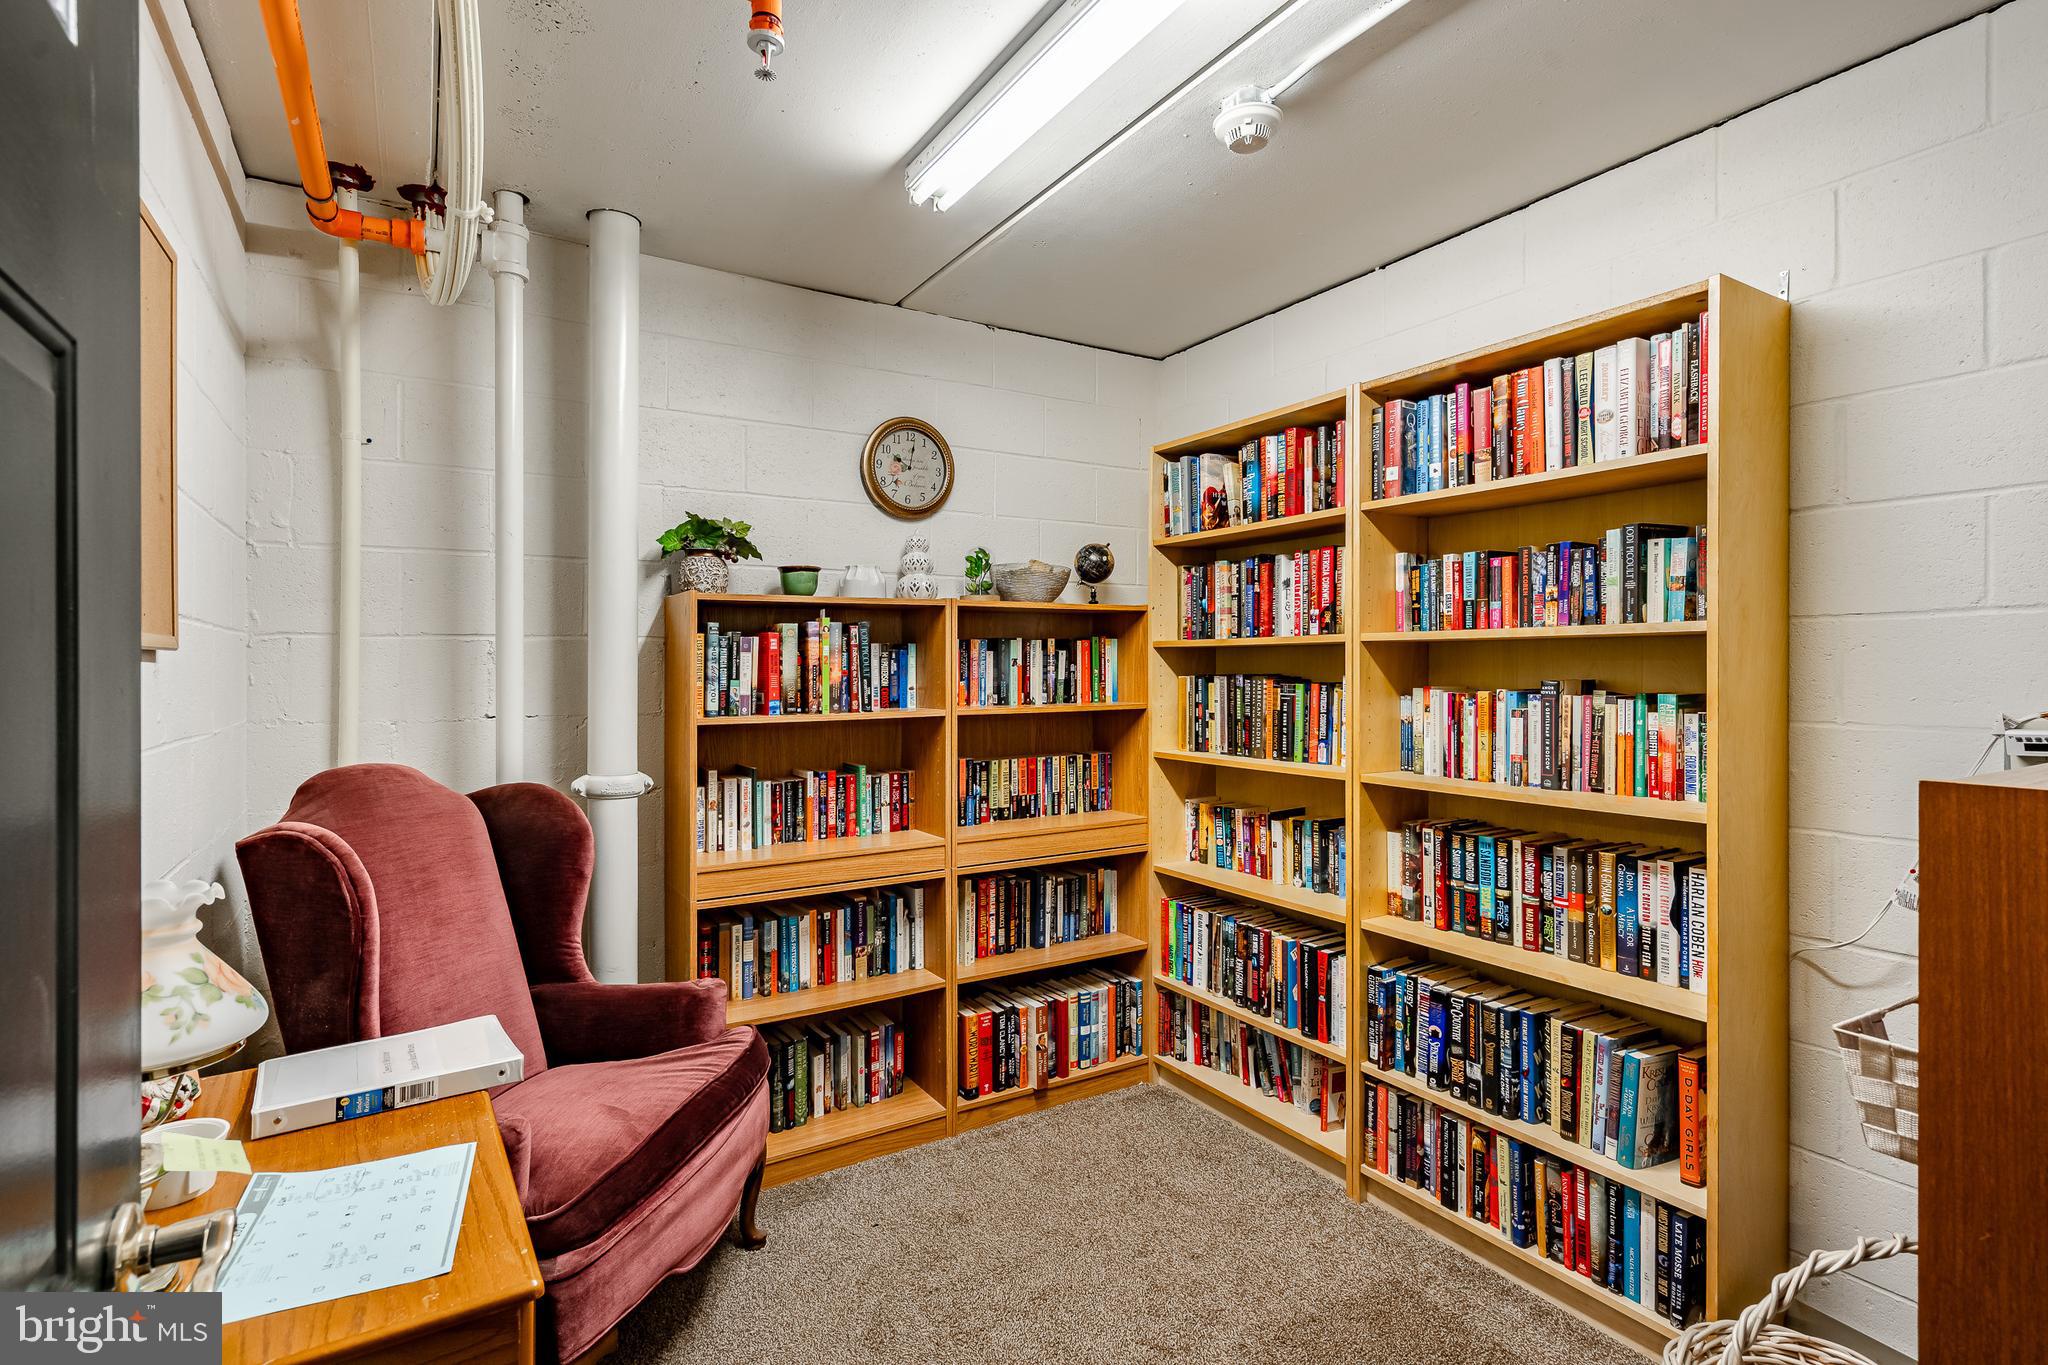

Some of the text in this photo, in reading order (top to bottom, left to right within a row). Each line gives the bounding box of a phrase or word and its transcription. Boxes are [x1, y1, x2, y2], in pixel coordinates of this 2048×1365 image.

[1517, 376, 1530, 396] Tom
[1690, 360, 1699, 402] FLASHBACK
[1580, 383, 1588, 405] CHILD
[1514, 399, 1530, 431] Clancy
[1620, 368, 1629, 448] ELIZABETH GEORGE
[893, 434, 900, 444] 11
[906, 432, 915, 442] 12
[923, 439, 926, 447] 1
[882, 444, 891, 454] 10
[932, 451, 937, 460] 2
[876, 459, 882, 469] 9
[1516, 450, 1525, 474] Rabbit
[880, 476, 886, 485] 8
[936, 468, 941, 477] 3
[892, 489, 897, 498] 7
[931, 483, 936, 491] 4
[905, 495, 911, 504] 6
[920, 493, 926, 502] 5
[1626, 546, 1634, 578] PICOULT
[1649, 731, 1658, 756] GRIFFIN
[1591, 754, 1599, 778] RUNNER
[1686, 756, 1696, 768] FOUR
[1480, 850, 1491, 886] SANDFORD
[1498, 842, 1508, 888] JOHN SANDFORD
[1525, 846, 1535, 893] JOHN SANDFORD
[1555, 873, 1564, 898] GRIFFIN
[1626, 872, 1634, 891] JOHN
[1642, 865, 1651, 922] MICHAEL CRICHTON
[1660, 865, 1670, 926] MICHAEL CRICHTON
[1626, 914, 1634, 932] TIME
[1690, 872, 1704, 958] HARLAN COBEN
[1642, 926, 1651, 944] STATE
[1642, 951, 1650, 967] FEAR
[969, 1030, 977, 1056] WORLD
[1685, 1078, 1694, 1170] D-DAY GIRLS
